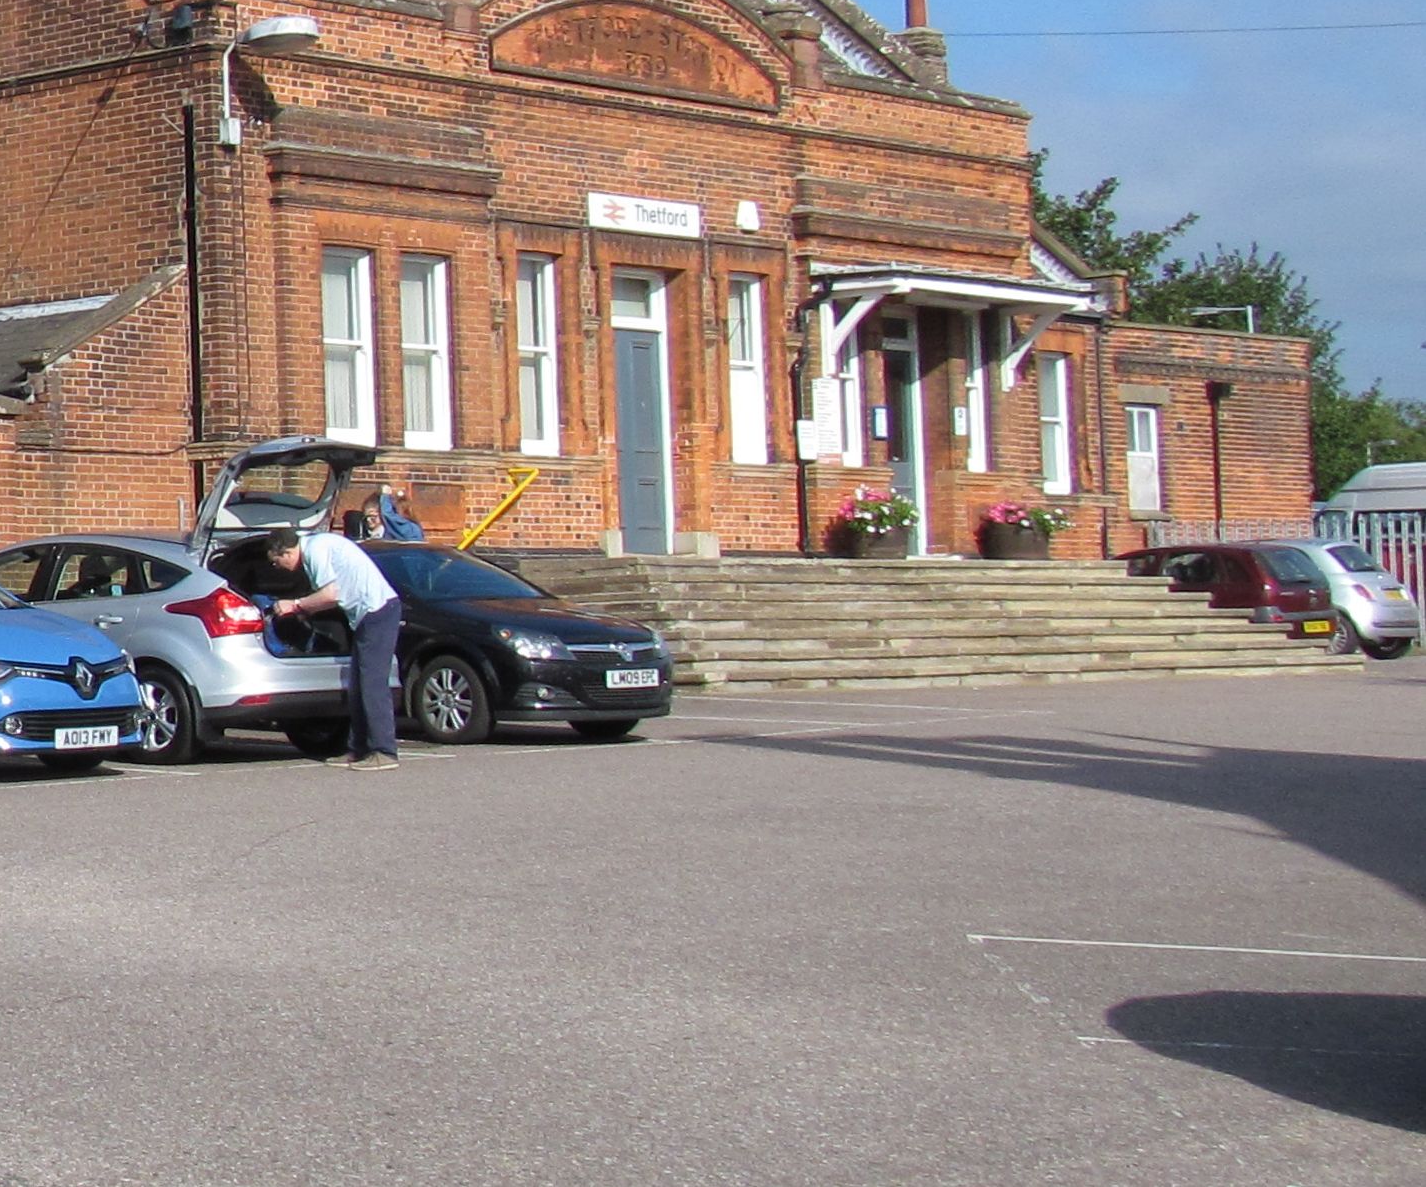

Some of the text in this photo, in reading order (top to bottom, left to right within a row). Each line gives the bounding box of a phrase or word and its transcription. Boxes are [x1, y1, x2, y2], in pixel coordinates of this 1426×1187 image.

[635, 204, 688, 227] Thetford
[63, 729, 112, 745] AO13 FMY
